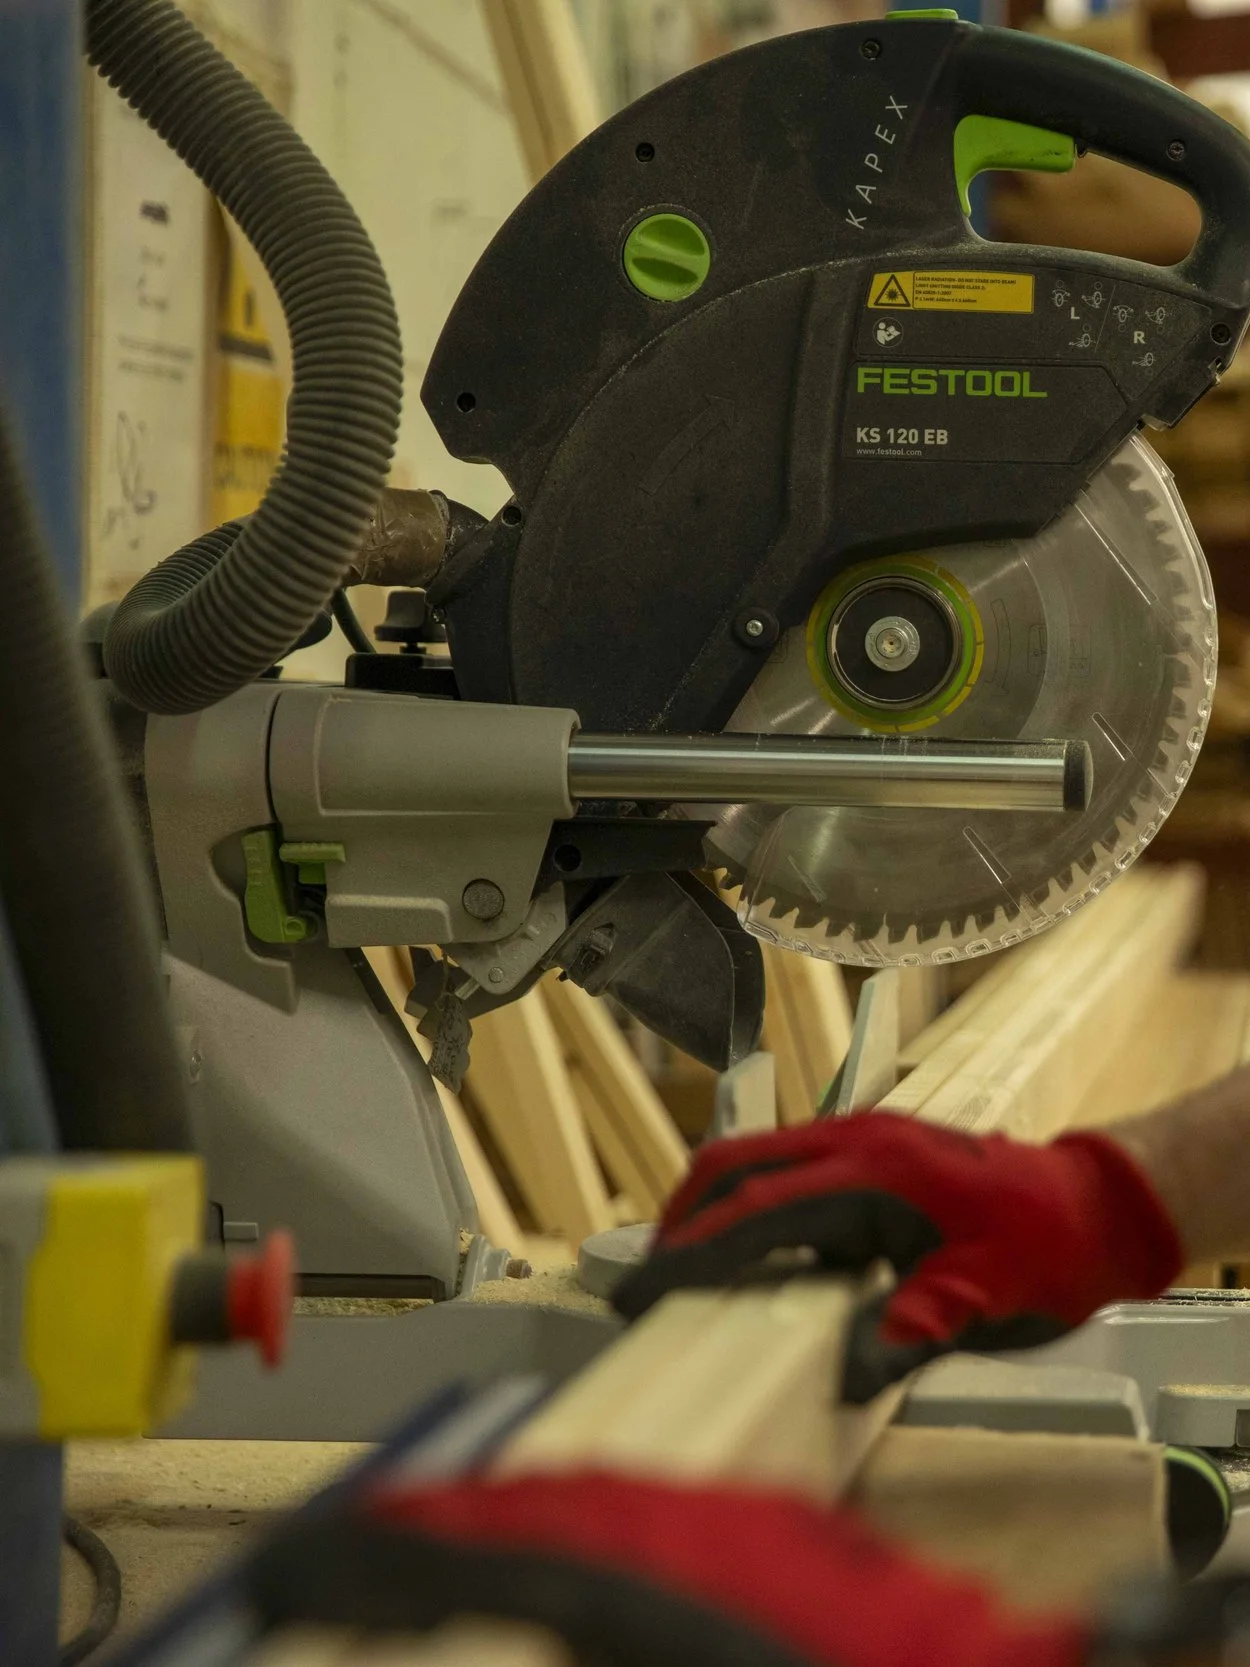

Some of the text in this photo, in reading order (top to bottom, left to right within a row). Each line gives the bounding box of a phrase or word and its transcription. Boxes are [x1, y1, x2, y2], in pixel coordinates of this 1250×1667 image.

[845, 95, 908, 230] KAPEX
[1070, 306, 1080, 320] L
[1133, 331, 1146, 344] R
[856, 367, 1048, 398] FESTOOL
[856, 427, 949, 445] KS 120 EB
[856, 447, 922, 456] www.festool.com
